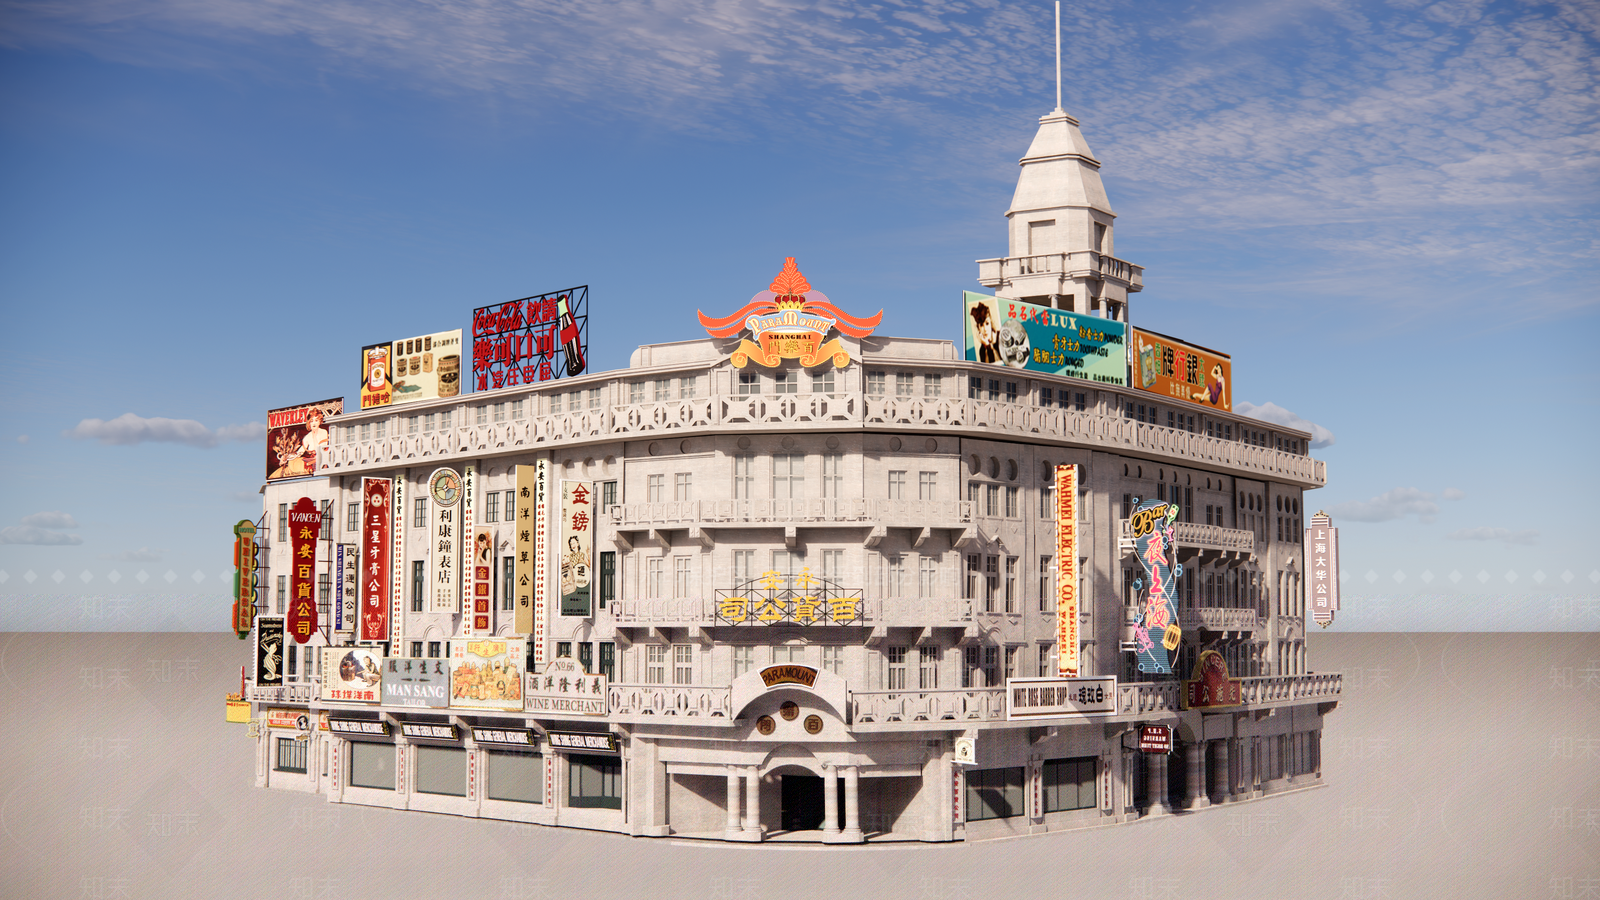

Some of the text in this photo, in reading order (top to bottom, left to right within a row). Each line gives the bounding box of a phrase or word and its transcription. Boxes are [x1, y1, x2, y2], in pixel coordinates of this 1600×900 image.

[1050, 313, 1078, 330] LUX
[269, 408, 310, 428] WAVERLEY
[520, 486, 530, 608] 南洋煙草公司
[1060, 474, 1074, 604] WAHMEI ELECTRIC CO.
[1131, 504, 1168, 538] Bar
[297, 526, 314, 636] 永安百貨公司
[368, 514, 382, 608] 三星牙膏公司
[1143, 531, 1170, 629] 夜上海
[1314, 529, 1327, 608] 上海大华公司
[386, 684, 444, 698] MAN SANG
[762, 667, 816, 685] PARAMOUNT
[526, 698, 604, 713] WINE MERCHANT
